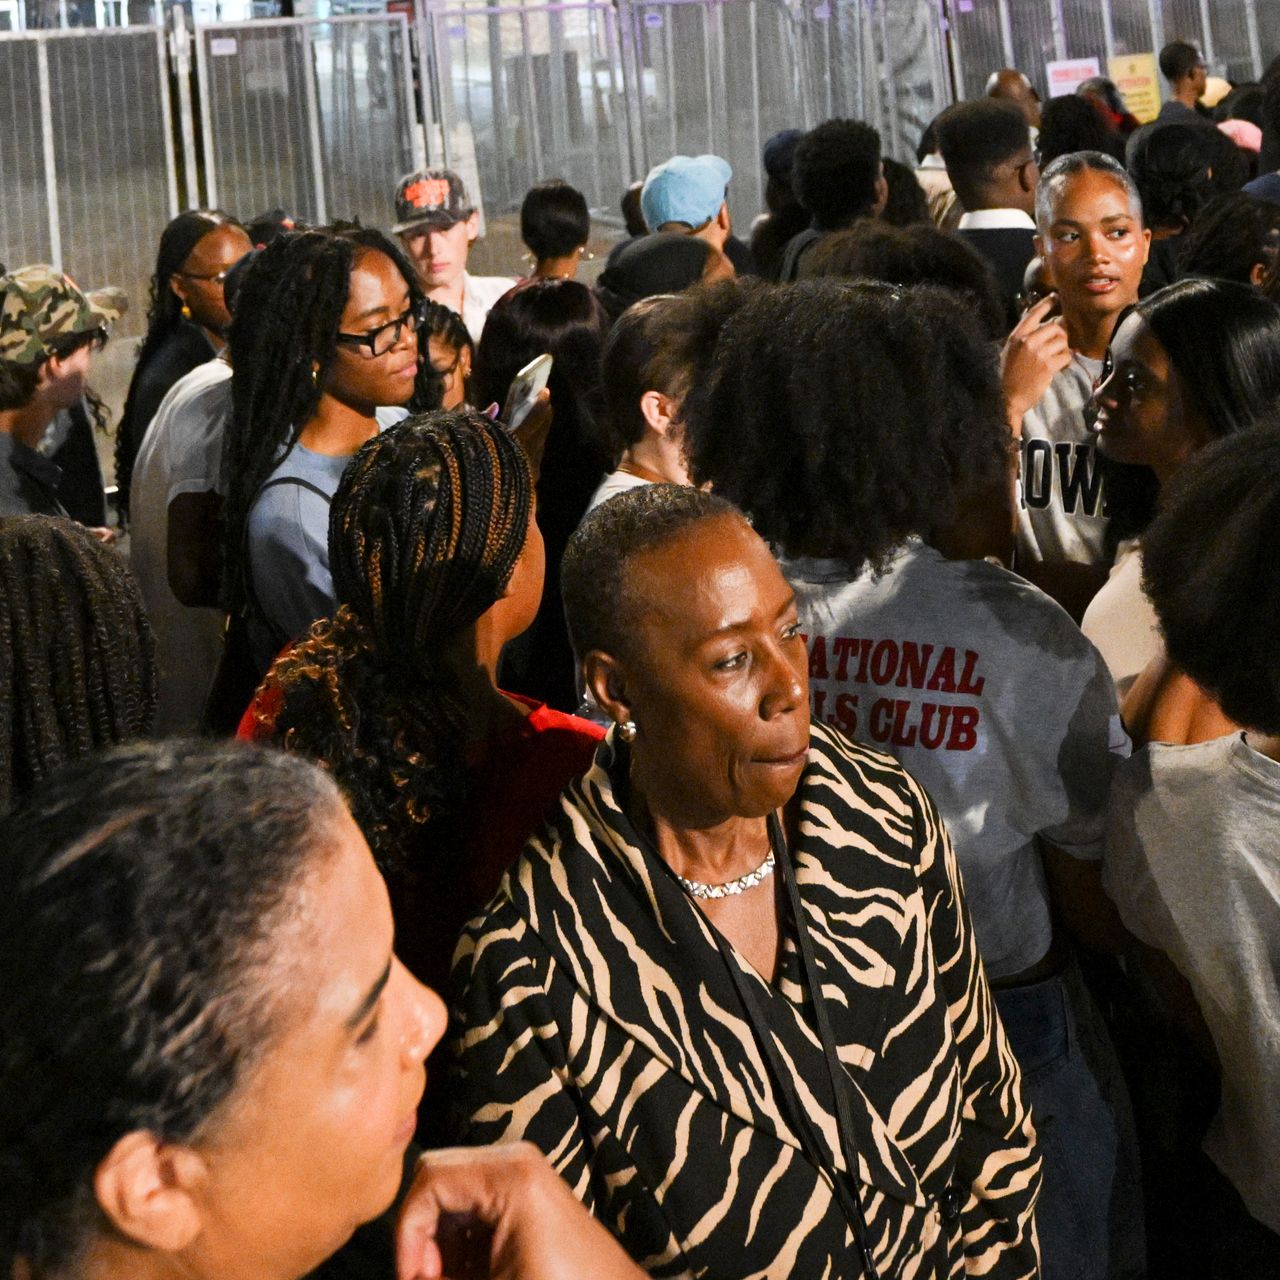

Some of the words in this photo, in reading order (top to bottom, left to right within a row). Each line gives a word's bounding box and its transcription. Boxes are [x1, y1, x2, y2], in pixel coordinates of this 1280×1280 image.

[1019, 437, 1110, 519] OW
[800, 634, 986, 697] ATIONAL
[808, 690, 859, 739] LS
[869, 697, 980, 751] CLUB
